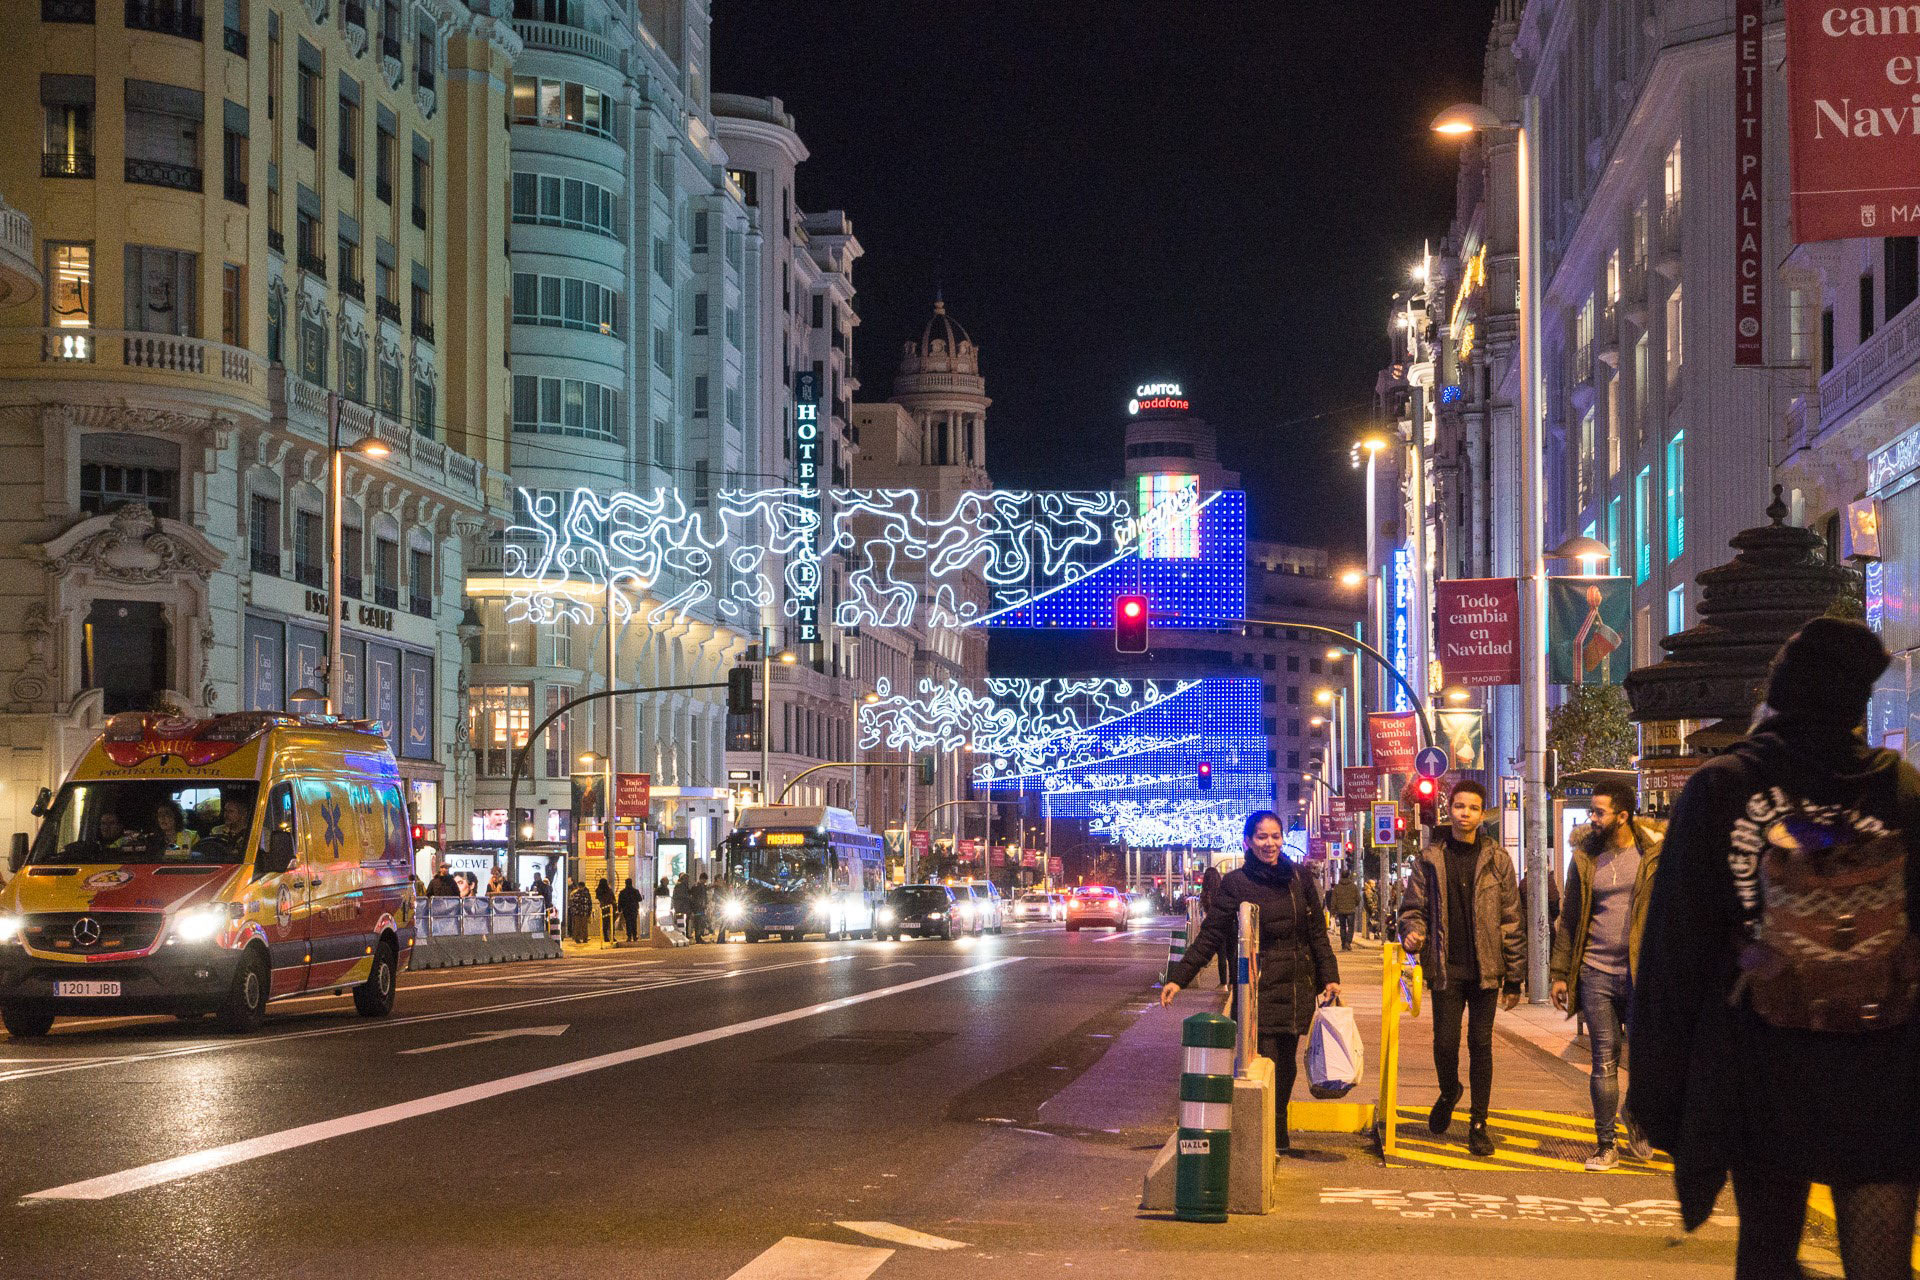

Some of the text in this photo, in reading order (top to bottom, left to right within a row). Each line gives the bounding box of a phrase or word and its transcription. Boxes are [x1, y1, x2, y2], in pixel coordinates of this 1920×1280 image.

[1886, 55, 1920, 85] e
[1814, 93, 1920, 140] Navi
[1741, 14, 1757, 304] PETIT PALACE
[1136, 383, 1183, 397] CAPITOL
[1138, 397, 1189, 410] vodafone
[797, 404, 817, 640] HOTEL REGENTE
[1395, 550, 1407, 609] HOTEL
[1456, 593, 1499, 609] Todo
[1449, 609, 1508, 625] cambia
[1469, 629, 1489, 640] en
[1447, 640, 1512, 657] Navidad
[1471, 675, 1501, 683] MADRID
[1380, 720, 1405, 729] Todo
[1376, 728, 1411, 739] cambia
[136, 740, 196, 754] SAMUR
[1388, 739, 1401, 747] en
[1375, 746, 1415, 758] Navidad
[187, 767, 222, 777] CIVIL
[624, 778, 642, 786] Todo
[1348, 779, 1374, 787] cambia
[1653, 776, 1668, 789] BUS
[618, 798, 647, 806] Navidad
[1348, 792, 1376, 800] Navidad
[749, 834, 756, 846] 1
[450, 859, 489, 869] LOEWE
[62, 983, 118, 995] 1201 JBD
[1319, 1186, 1684, 1208] ZONA
[1320, 1196, 1684, 1216] PEATONA
